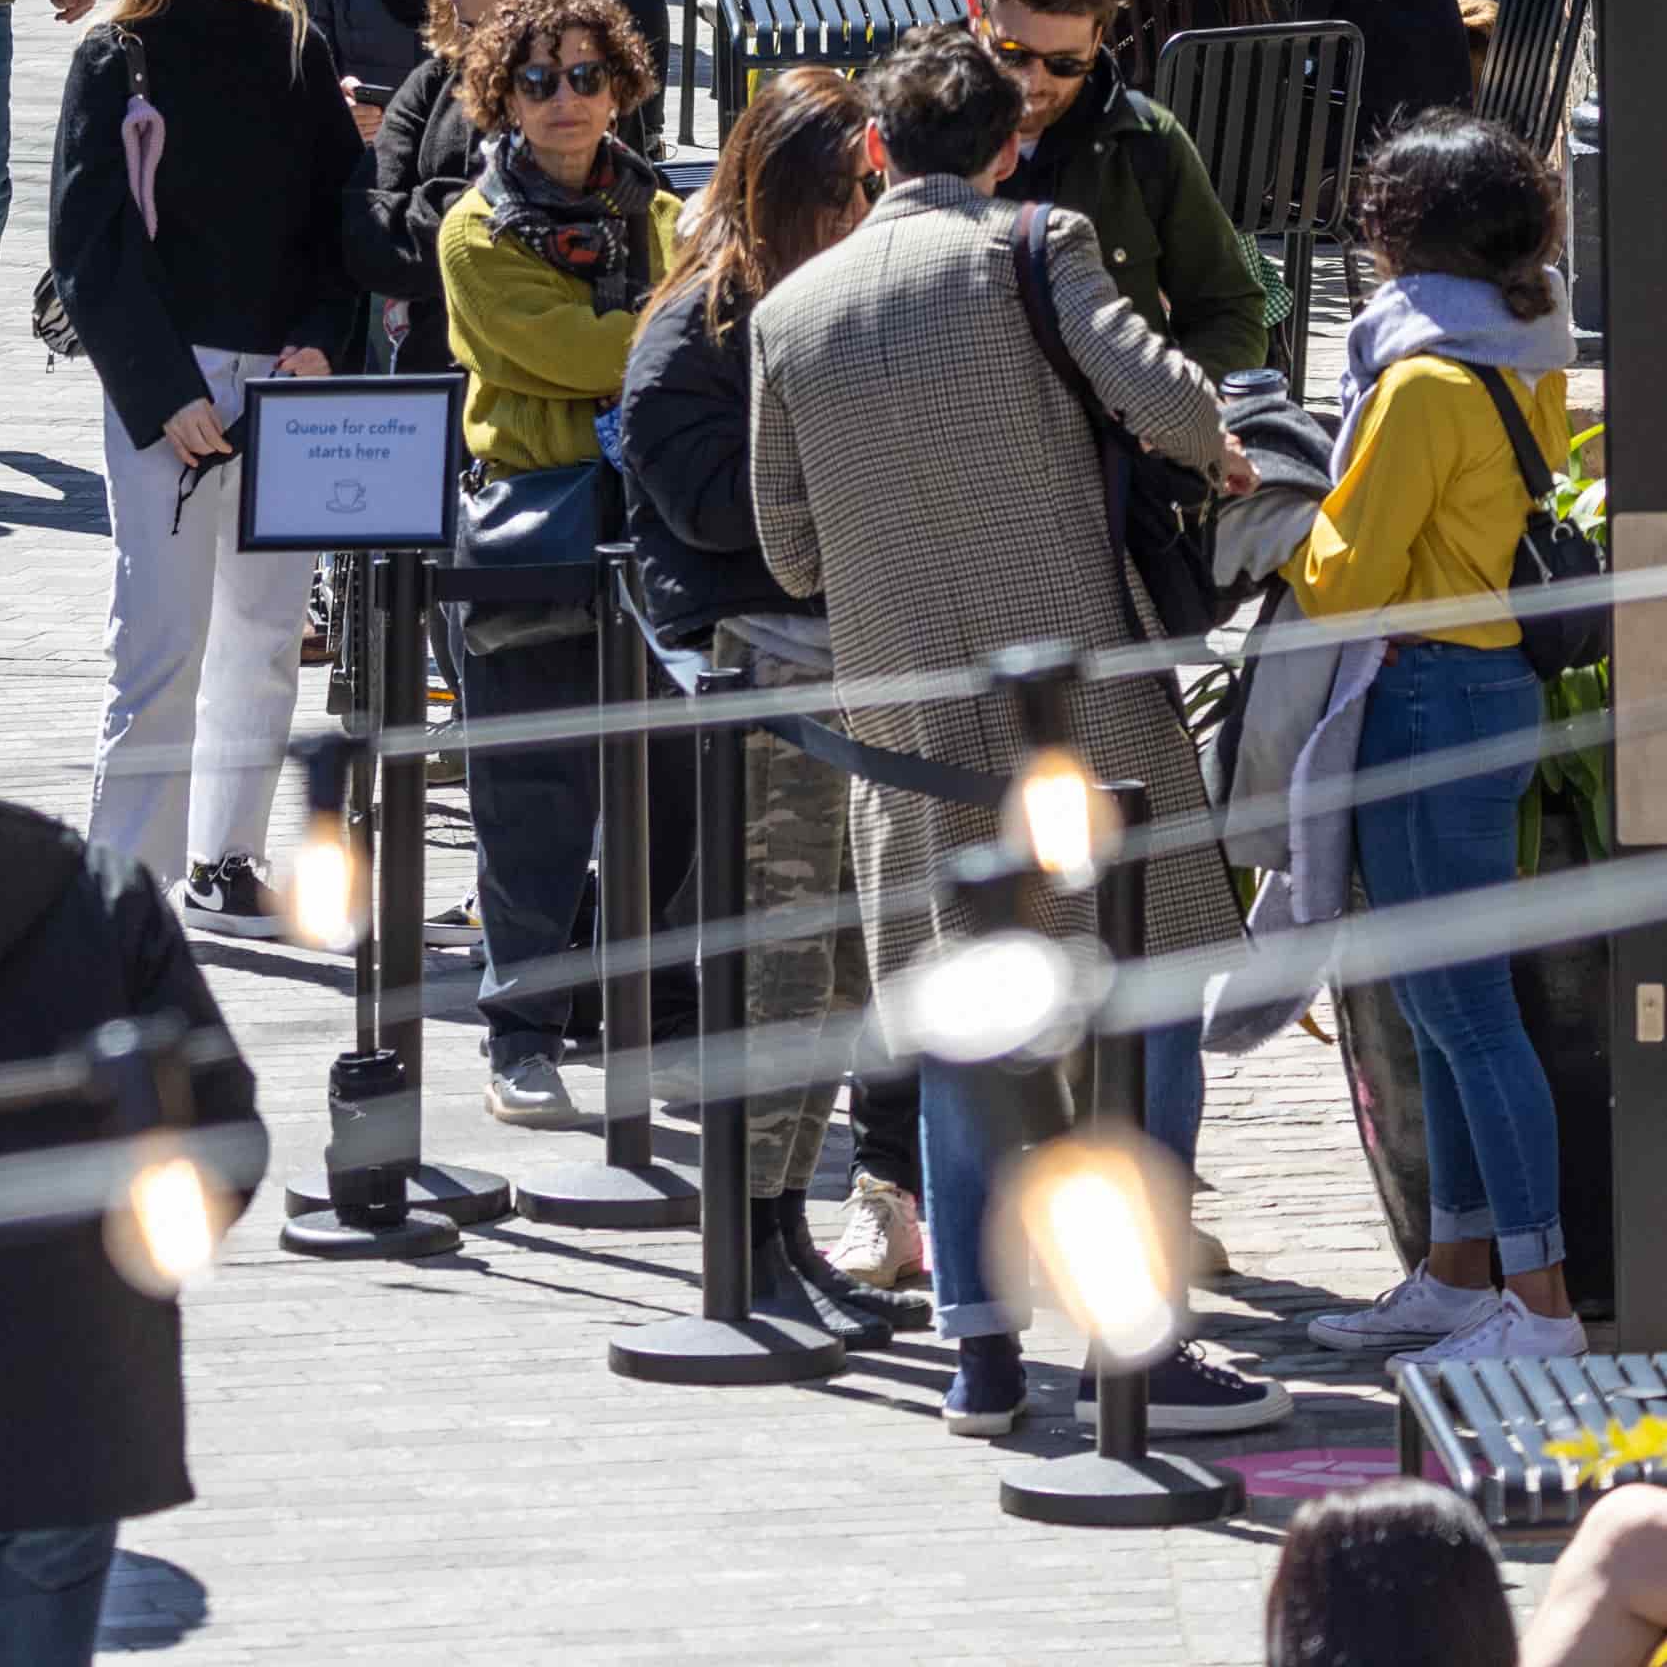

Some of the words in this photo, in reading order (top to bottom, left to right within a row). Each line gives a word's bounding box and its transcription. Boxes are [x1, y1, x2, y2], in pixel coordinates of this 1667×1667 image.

[285, 419, 337, 436] Queue
[342, 418, 365, 436] for
[369, 418, 417, 436] coffee
[308, 443, 351, 459] starts
[356, 443, 390, 459] here
